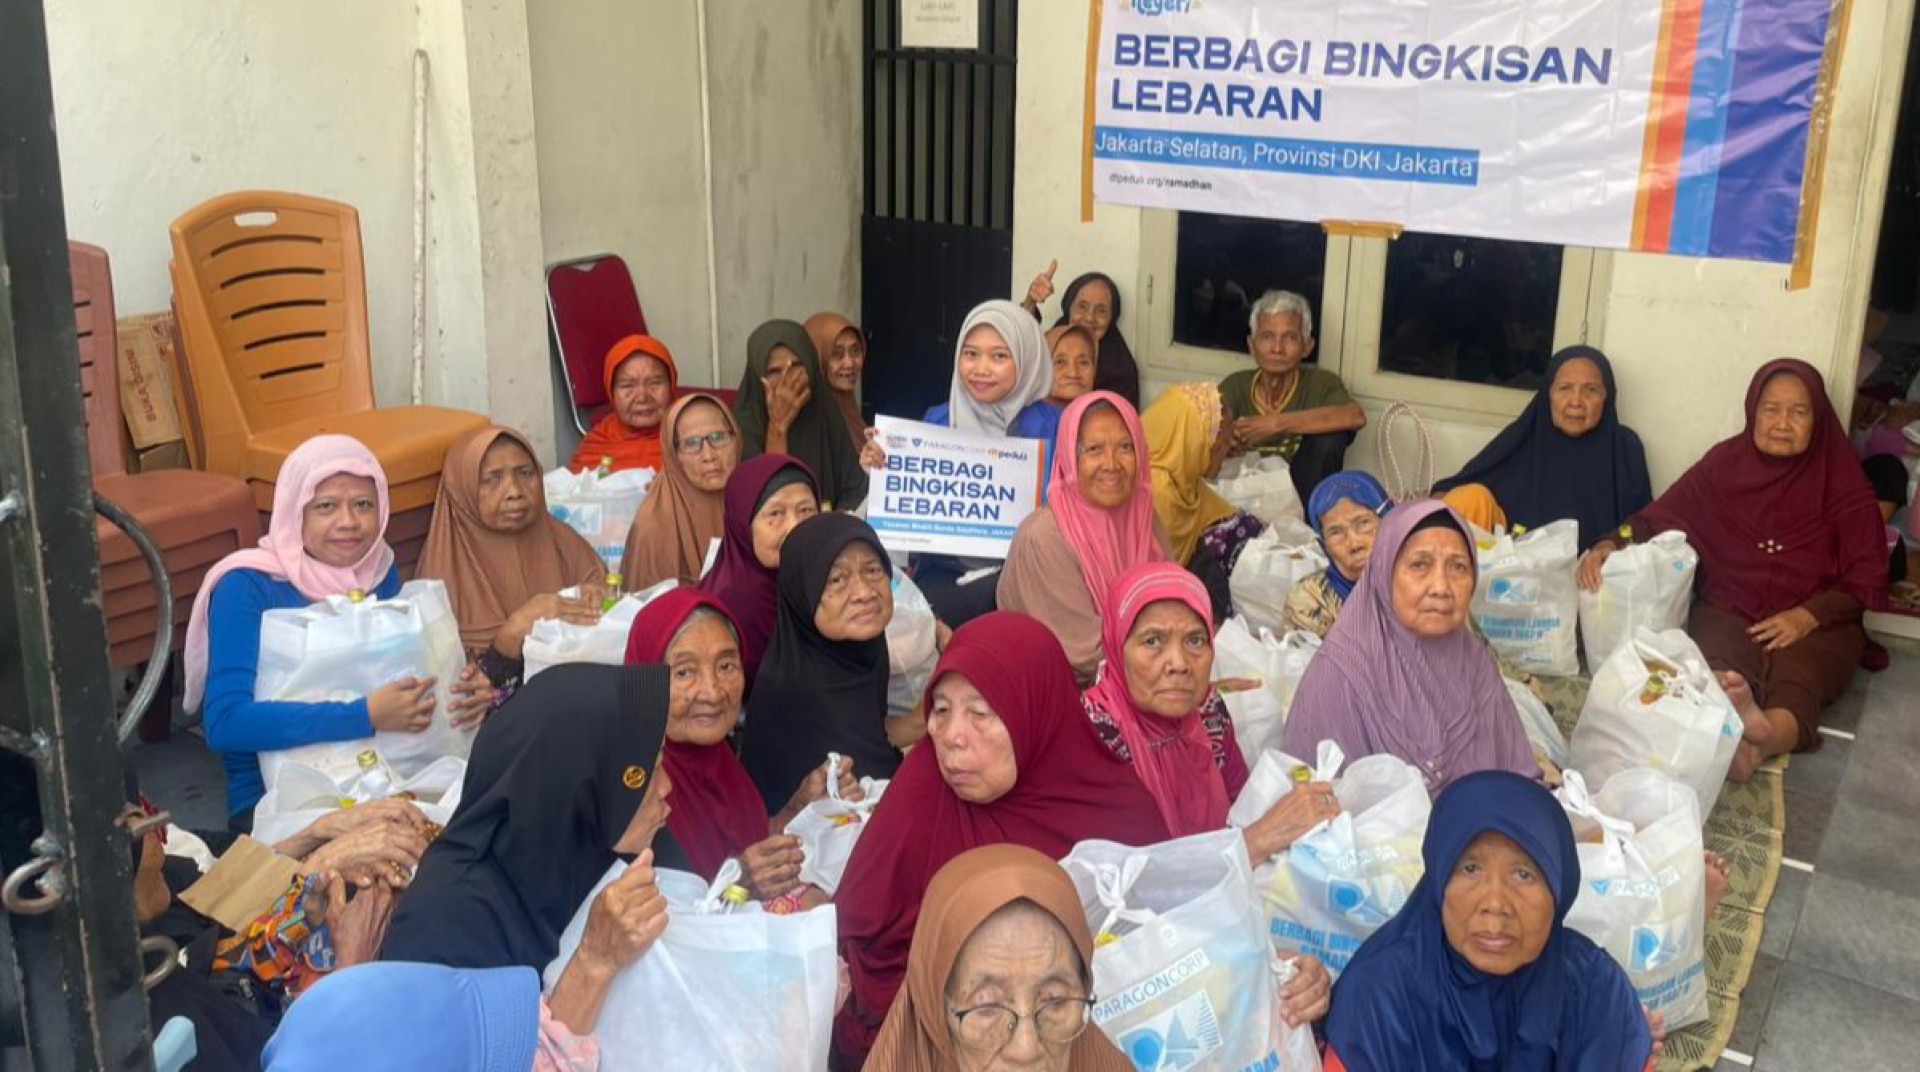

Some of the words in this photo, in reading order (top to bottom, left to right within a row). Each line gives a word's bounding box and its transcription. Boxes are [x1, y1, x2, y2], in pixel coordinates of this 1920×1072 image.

[1114, 33, 1310, 75] BERBAGI
[1323, 41, 1613, 86] BINGKISAN
[1111, 78, 1323, 123] LEBARAN
[1095, 133, 1164, 157] Jakarta
[1169, 137, 1248, 164] Selatan,
[1253, 144, 1337, 168] Provinsi
[1342, 149, 1380, 170] DKI
[1386, 151, 1474, 178] Jakarta
[885, 474, 1015, 503] BINGKISAN
[886, 454, 993, 481] BERBAGI
[884, 495, 1000, 521] LEBARAN
[1094, 951, 1203, 1020] PARAGONCORP
